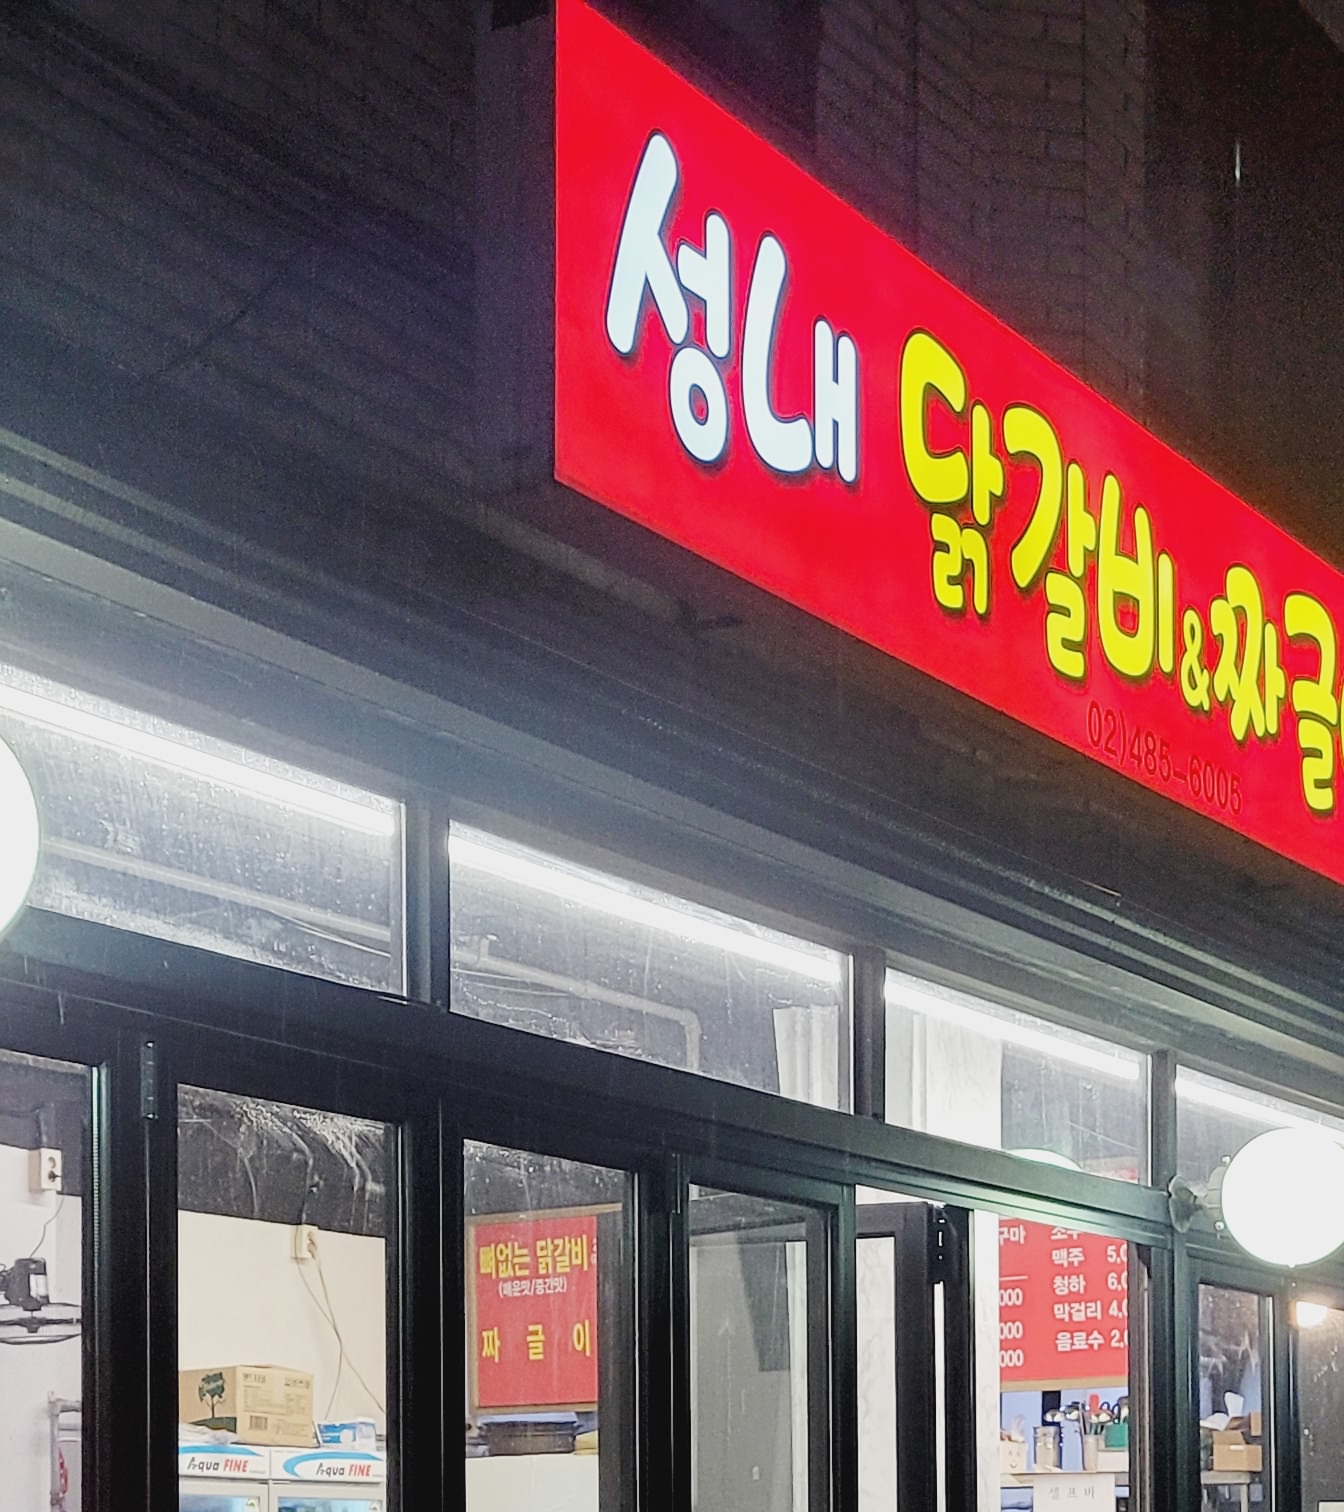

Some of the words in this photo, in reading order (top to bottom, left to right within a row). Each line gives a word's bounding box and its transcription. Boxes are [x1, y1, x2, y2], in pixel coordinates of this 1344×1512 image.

[606, 130, 858, 484] 성내
[1087, 700, 1242, 816] 02)485-6005
[479, 1241, 531, 1279] 뼈없는
[536, 1234, 588, 1273] 닭갈비
[1051, 1247, 1086, 1268] 맥주
[1053, 1274, 1086, 1296] 청하
[1053, 1300, 1102, 1322] 막걸리
[481, 1319, 591, 1363] 짜글이
[1055, 1330, 1105, 1352] 음료수
[223, 1458, 249, 1473] FINE
[348, 1464, 372, 1478] FINE
